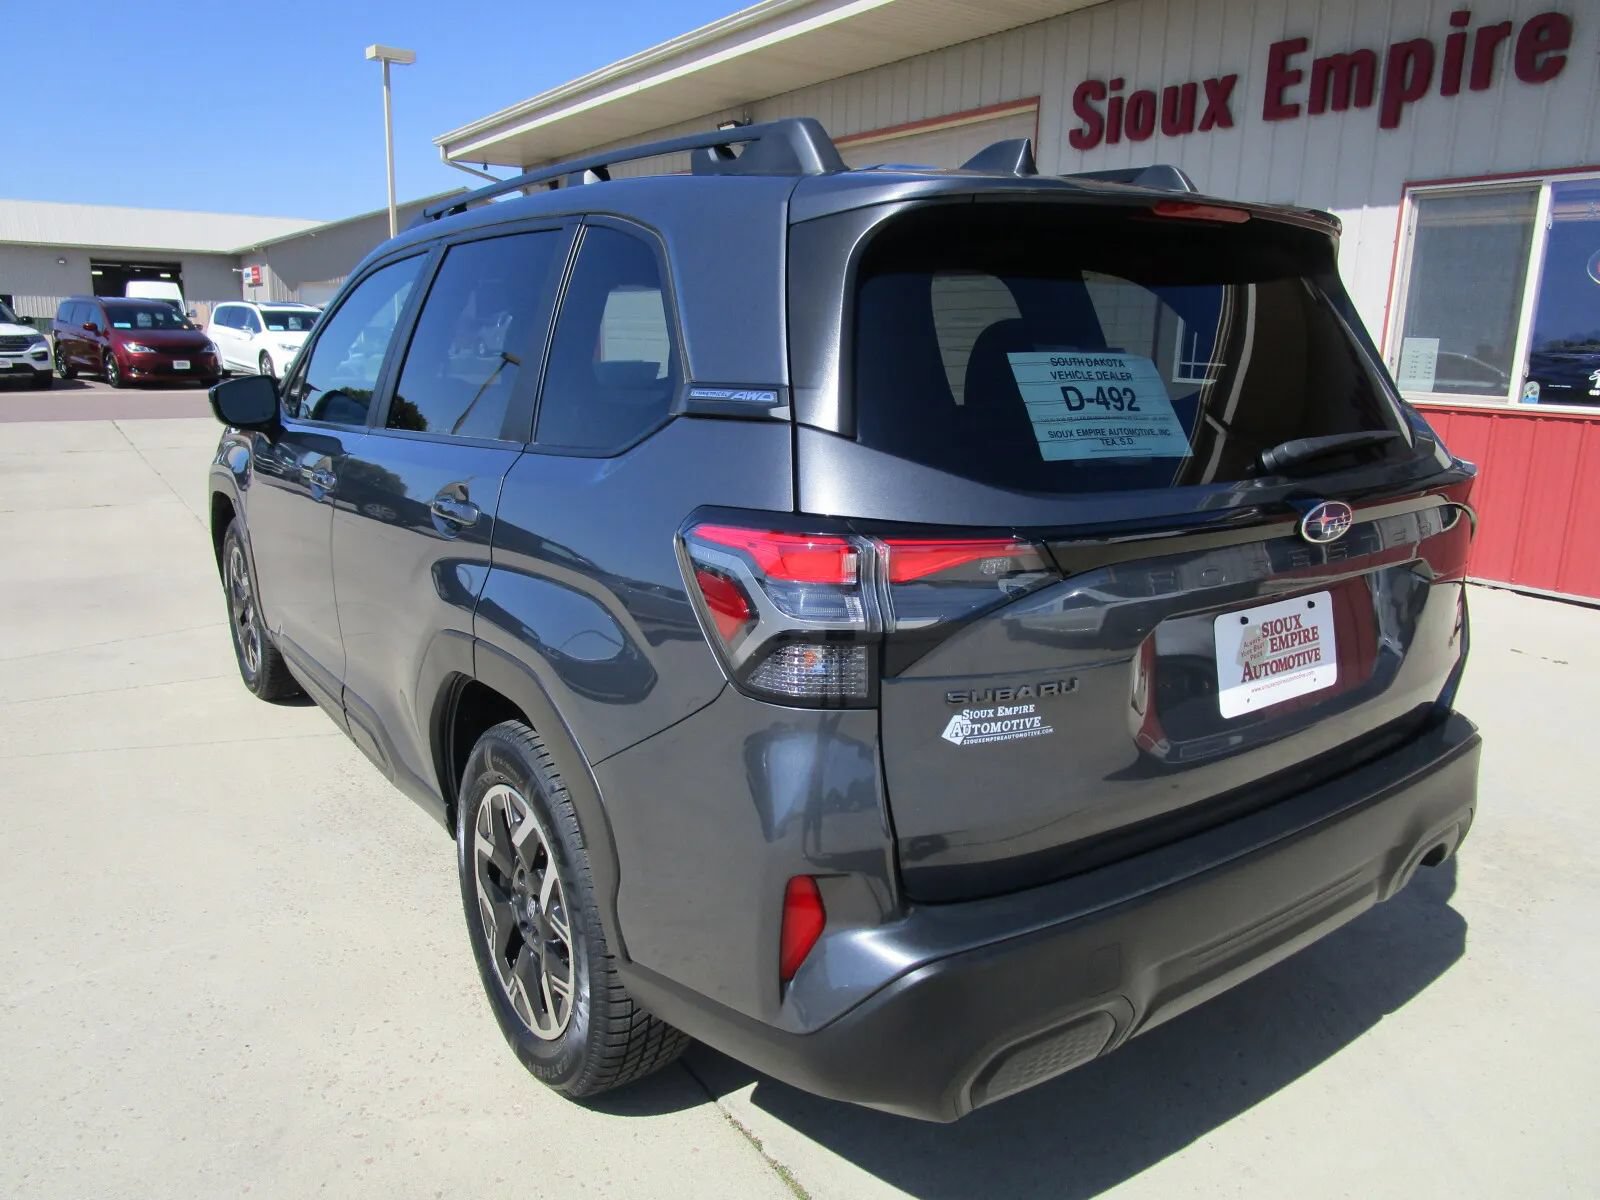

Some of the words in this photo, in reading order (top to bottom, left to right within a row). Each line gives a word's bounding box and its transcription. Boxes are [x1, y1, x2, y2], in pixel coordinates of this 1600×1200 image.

[1069, 73, 1239, 151] Sioux
[1262, 10, 1574, 129] Empire
[1050, 357, 1085, 367] SOUTH
[1086, 358, 1126, 368] DAKOTA
[1050, 370, 1095, 380] VEHICLE
[1095, 371, 1133, 381] DEALER
[731, 391, 775, 401] AWD
[1060, 385, 1141, 412] D-492
[1048, 430, 1075, 439] SIOUX
[1076, 428, 1106, 437] EMPIRE
[1261, 613, 1303, 638] SIOUX
[1268, 625, 1320, 654] EMPIRE
[1241, 648, 1321, 683] AUTOMOTIVE
[945, 677, 1080, 705] SUBARU
[962, 708, 994, 720] SIOUX
[997, 704, 1036, 717] EMPIRE
[950, 716, 1042, 737] AUTOMOTIVE
